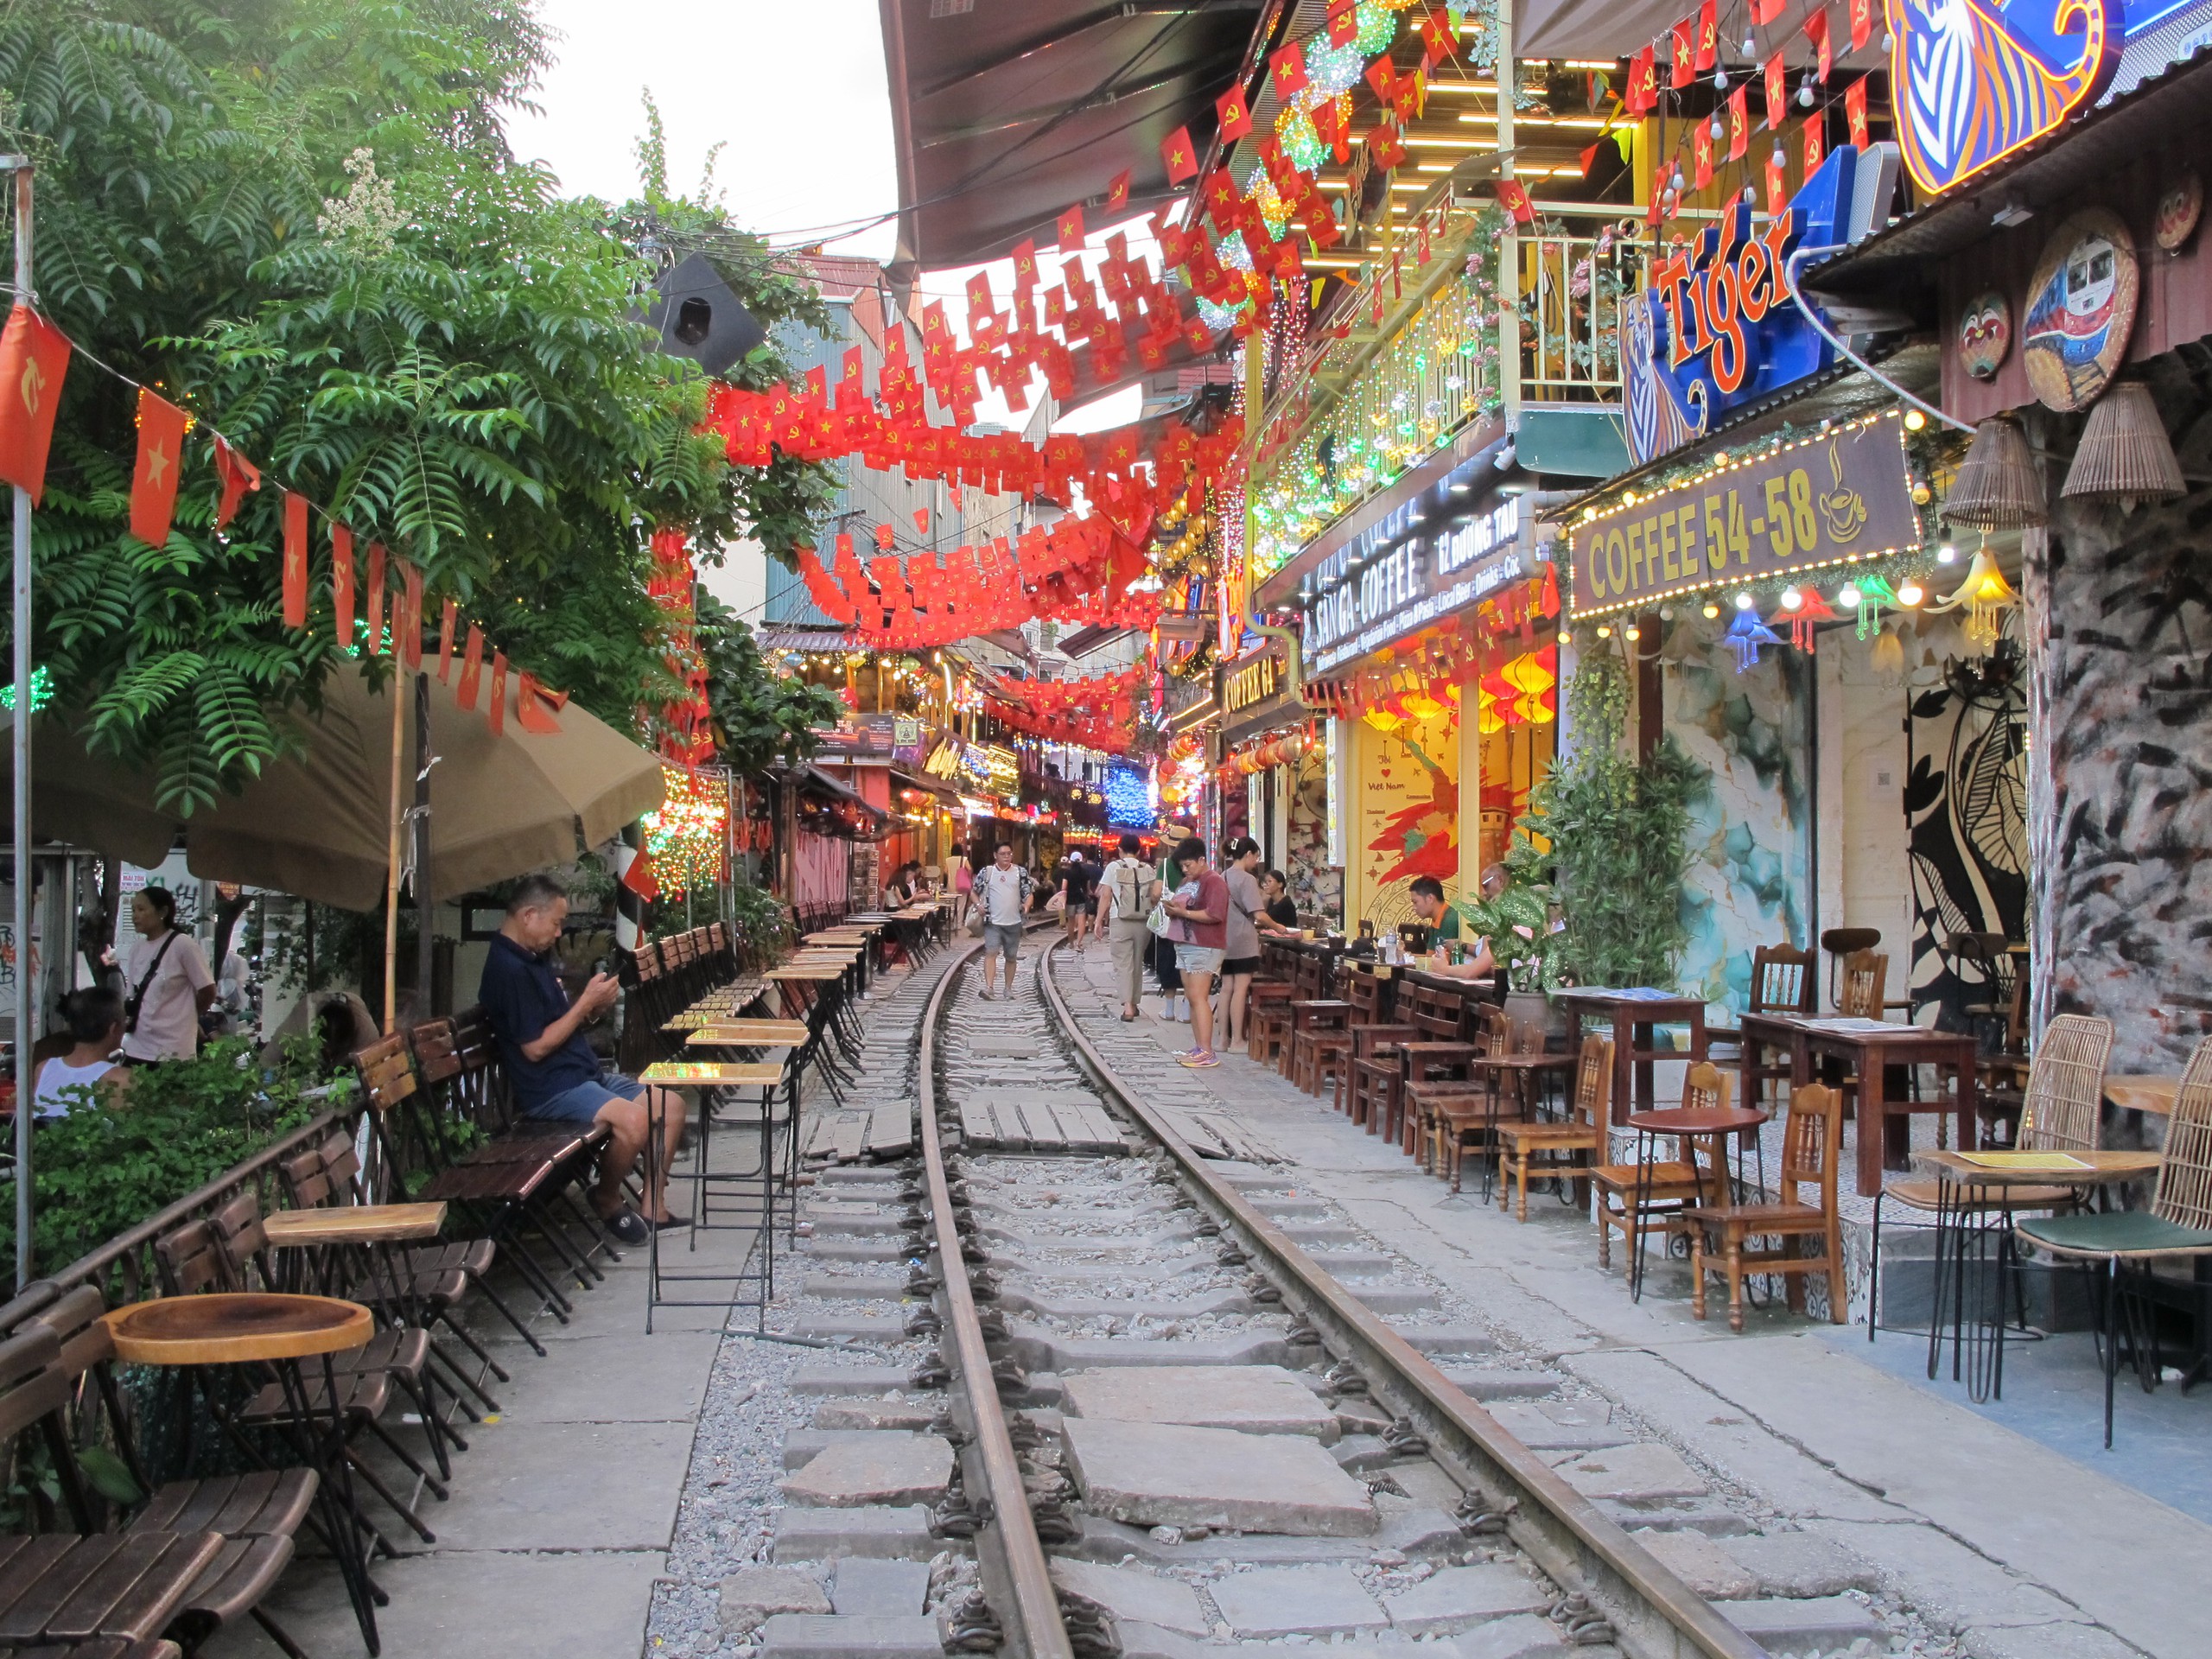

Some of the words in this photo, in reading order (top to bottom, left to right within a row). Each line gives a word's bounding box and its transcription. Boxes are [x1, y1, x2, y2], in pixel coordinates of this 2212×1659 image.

[1658, 203, 1794, 394] Tiger
[1589, 504, 1699, 599] COFFEE
[1704, 468, 1817, 570] 54-58
[1438, 584, 1456, 613] Local
[1455, 582, 1471, 606] Beer
[1475, 565, 1499, 596] Drinks
[1224, 662, 1261, 714] COFFEE
[1262, 655, 1274, 696] 64
